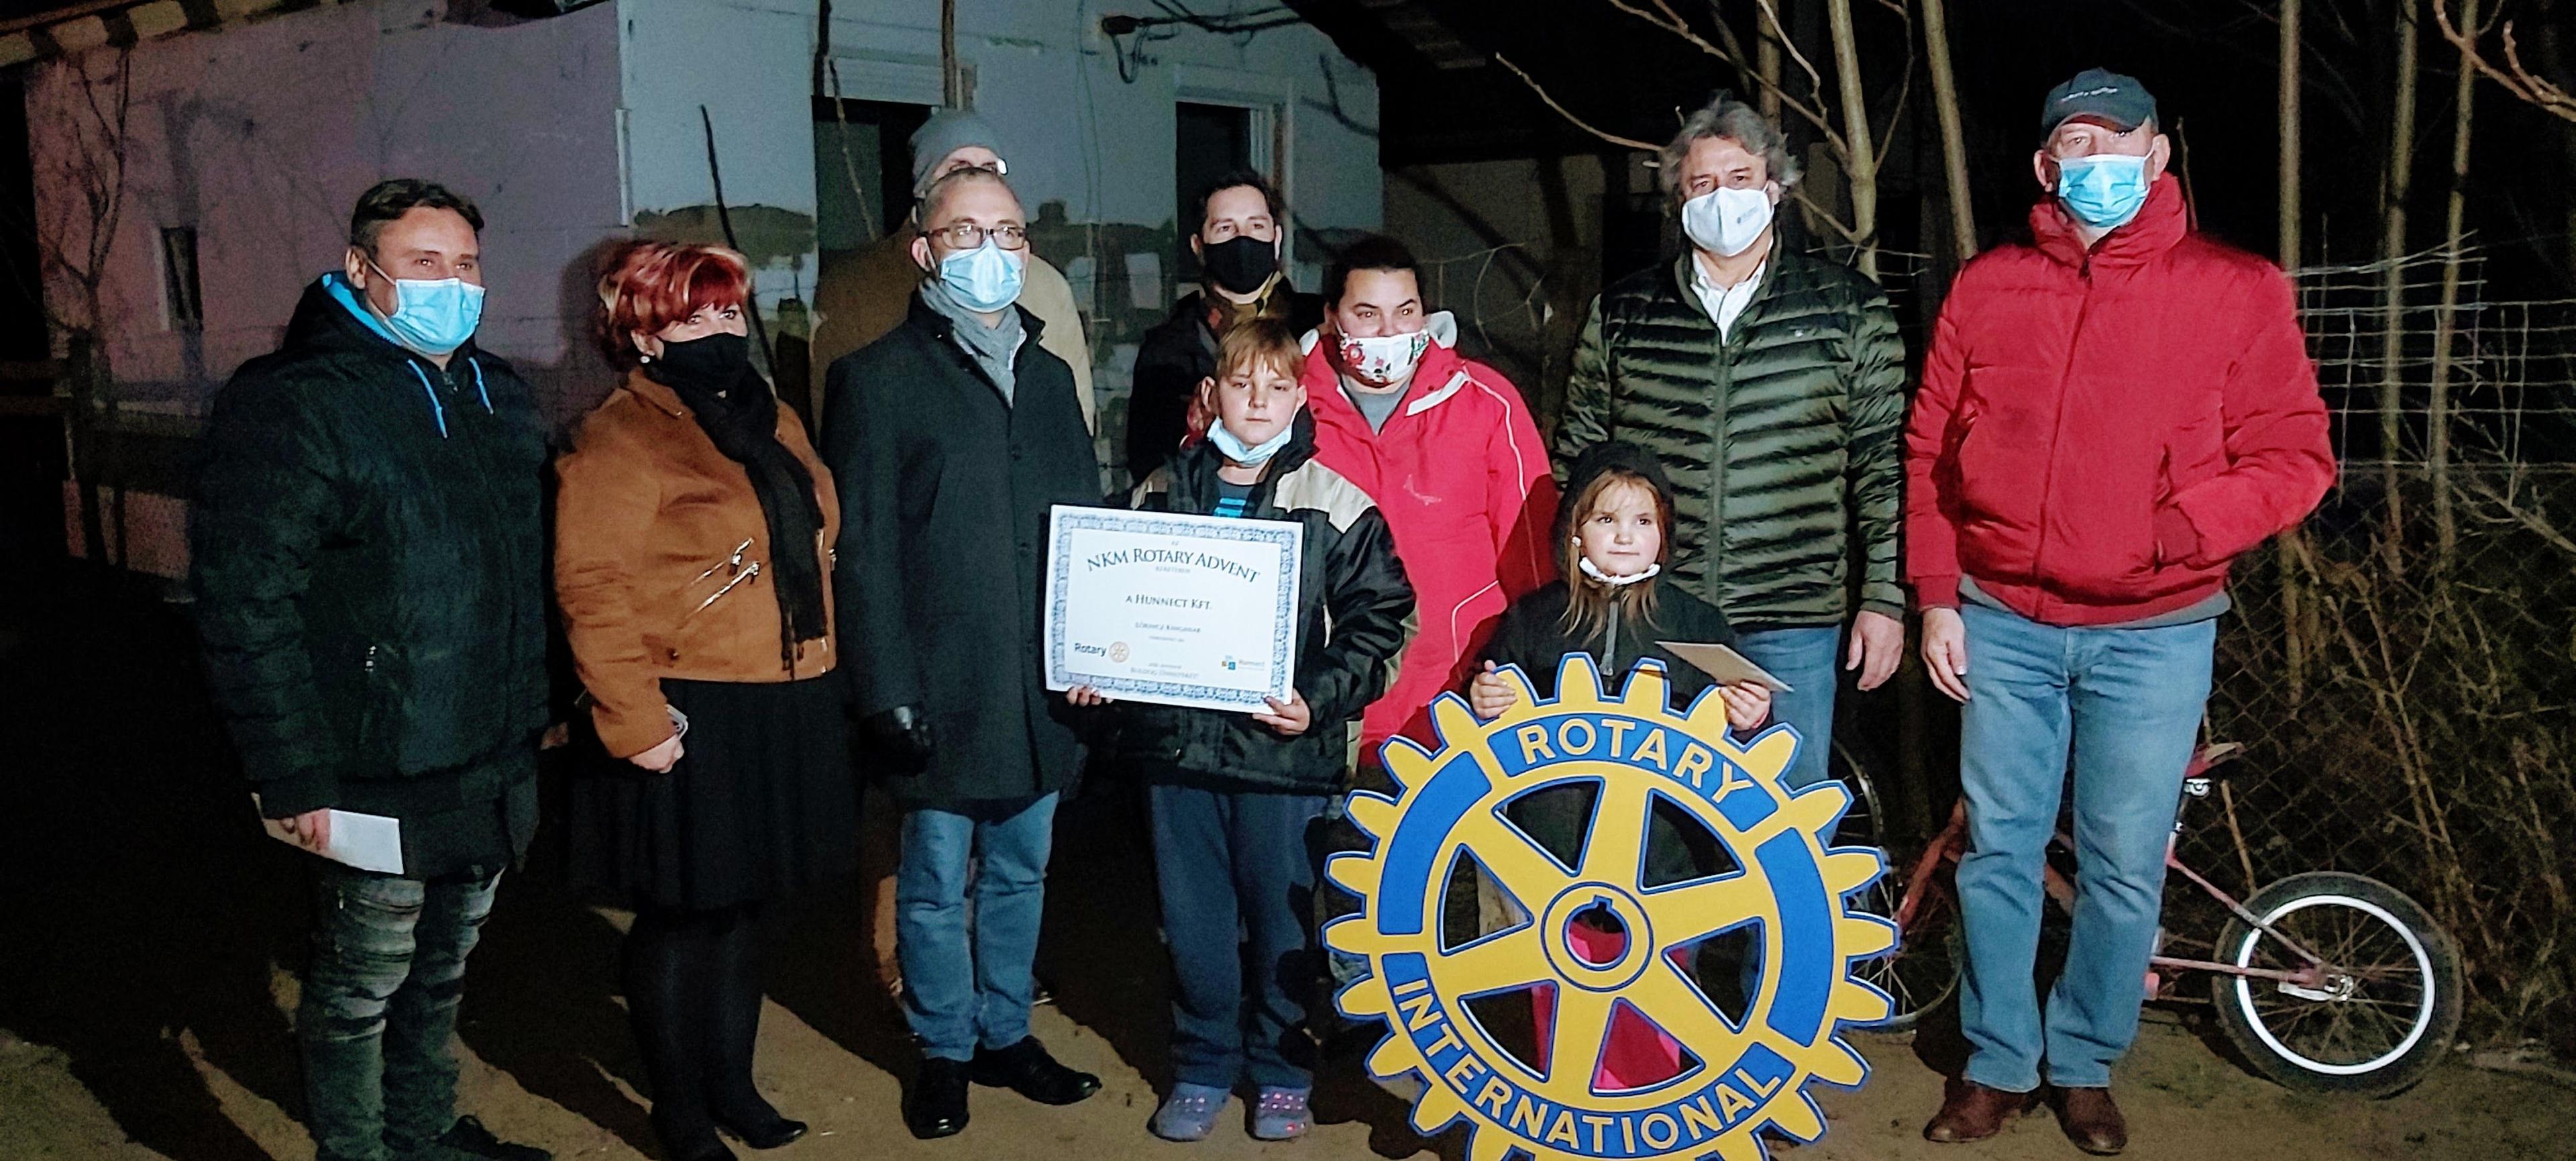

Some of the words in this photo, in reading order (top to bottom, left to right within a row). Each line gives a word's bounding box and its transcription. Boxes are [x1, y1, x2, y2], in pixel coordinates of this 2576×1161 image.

[1087, 550, 1128, 572] NKM
[1133, 548, 1194, 564] ROTARY
[1195, 552, 1261, 583] ADVENT
[1135, 594, 1188, 608] HUNNECT
[1075, 642, 1107, 657] Rotary
[1517, 718, 1754, 804] ROTARY
[1392, 980, 1782, 1154] INTERNATIONAL
